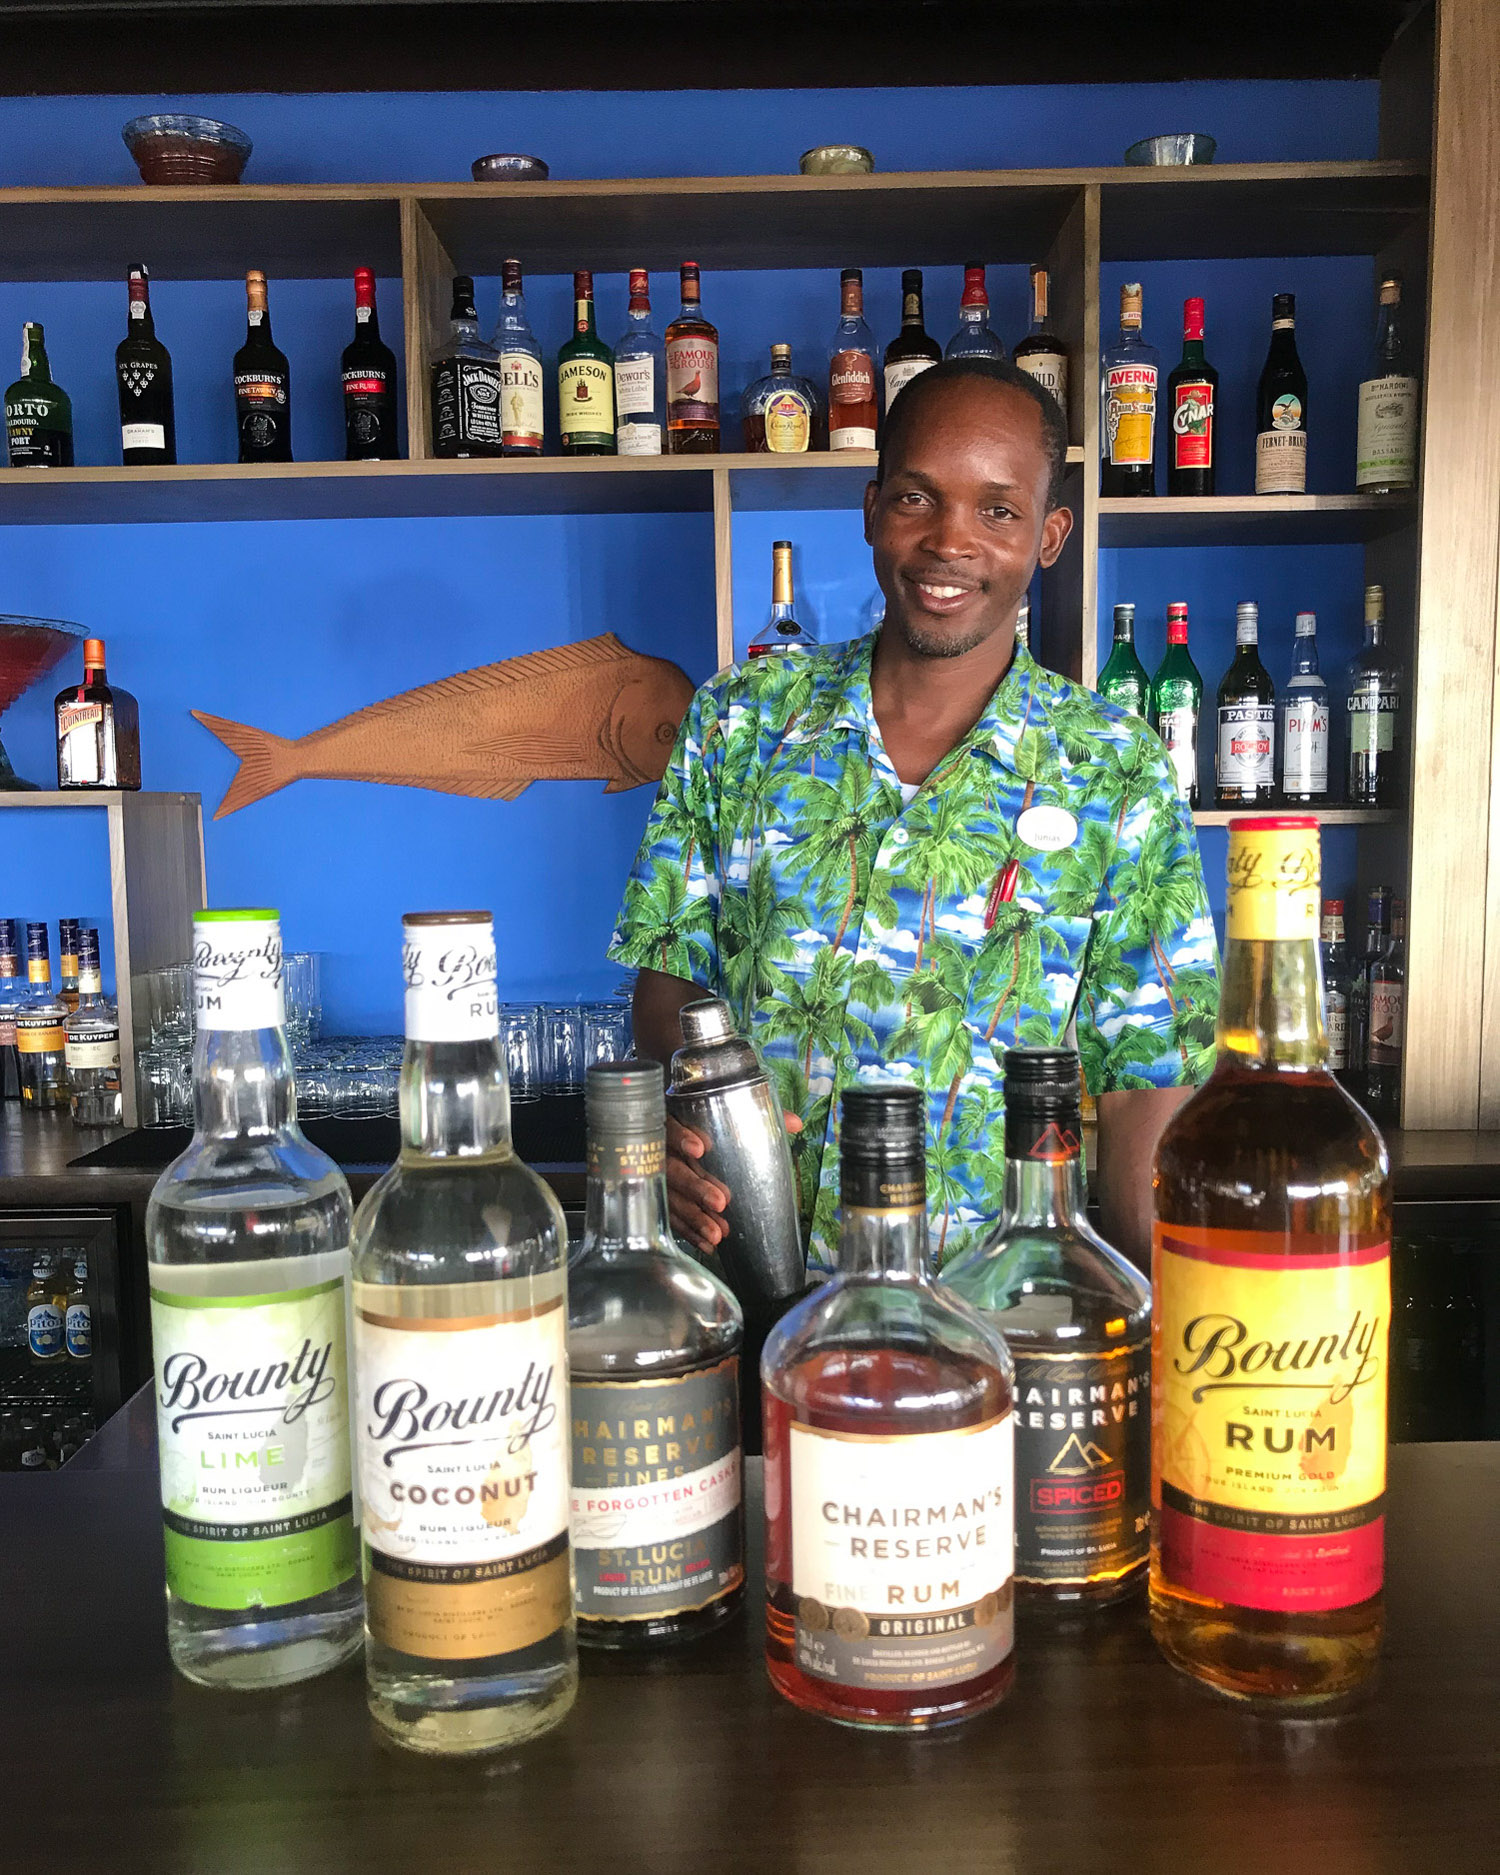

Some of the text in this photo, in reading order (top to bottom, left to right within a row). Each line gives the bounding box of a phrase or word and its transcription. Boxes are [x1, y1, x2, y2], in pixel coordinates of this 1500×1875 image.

[674, 350, 714, 361] FAMOUS
[130, 361, 158, 370] GRAPES
[674, 359, 714, 370] GROUSE
[503, 371, 539, 388] ELL'S
[560, 365, 607, 384] JAMESON
[617, 370, 650, 383] Dewar's
[832, 371, 870, 386] Glenfiddich
[1109, 370, 1155, 386] AVERNA
[6, 403, 49, 417] ORTO
[1173, 402, 1214, 434] CYNAR
[11, 437, 30, 446] PORT
[1347, 696, 1399, 711] CAMPARI
[63, 708, 100, 731] COINTREAU
[1226, 709, 1274, 722] PASTIS
[1288, 715, 1328, 733] PIM'S
[198, 997, 222, 1010] UM
[470, 1003, 496, 1017] RU
[25, 1018, 58, 1027] KUYPER
[79, 1032, 115, 1041] KUYPER
[30, 1318, 63, 1329] Piton
[67, 1317, 90, 1329] Pito
[1173, 1309, 1380, 1405] Bounty
[160, 1338, 337, 1424] Bounty
[1013, 1370, 1150, 1407] HAIRMAN'S
[366, 1361, 557, 1455] Bounty
[1012, 1400, 1138, 1430] RESERVE
[1243, 1405, 1281, 1418] SAINT
[574, 1398, 732, 1439] HAIRMAN'S
[207, 1428, 278, 1441] SAINT LUCIA
[1224, 1421, 1337, 1454] RUM
[200, 1446, 286, 1470] LIME
[582, 1433, 716, 1467] RESERVE
[427, 1465, 461, 1474] SAINT
[1225, 1466, 1336, 1481] PREMIUM GOLD
[202, 1482, 289, 1495] RUM LIQUEUR
[389, 1471, 539, 1506] COCONUT
[587, 1460, 738, 1513] FORGOTTEN CASKS
[1036, 1479, 1122, 1506] SPICED
[821, 1485, 1002, 1528] CHAIRMAN'S
[193, 1524, 227, 1537] SPIRIT
[232, 1527, 249, 1538] OF
[253, 1521, 291, 1537] SAINT
[295, 1511, 328, 1529] LUCIA
[419, 1518, 512, 1533] RUM LIQUEUR
[1214, 1510, 1260, 1527] SPIRIT
[1264, 1517, 1284, 1530] OF
[1289, 1517, 1331, 1531] SAINT
[850, 1525, 987, 1559] RESERVE
[598, 1549, 631, 1568] ST.
[637, 1539, 707, 1567] LUCIA
[1075, 1547, 1085, 1555] OF
[407, 1549, 548, 1580] SPIRIT OF SAINT LUCIA
[630, 1563, 682, 1586] RUM
[887, 1580, 960, 1605] RUM
[880, 1613, 967, 1636] ORIGINAL
[911, 1672, 926, 1682] OF
[926, 1667, 955, 1681] SAINT
